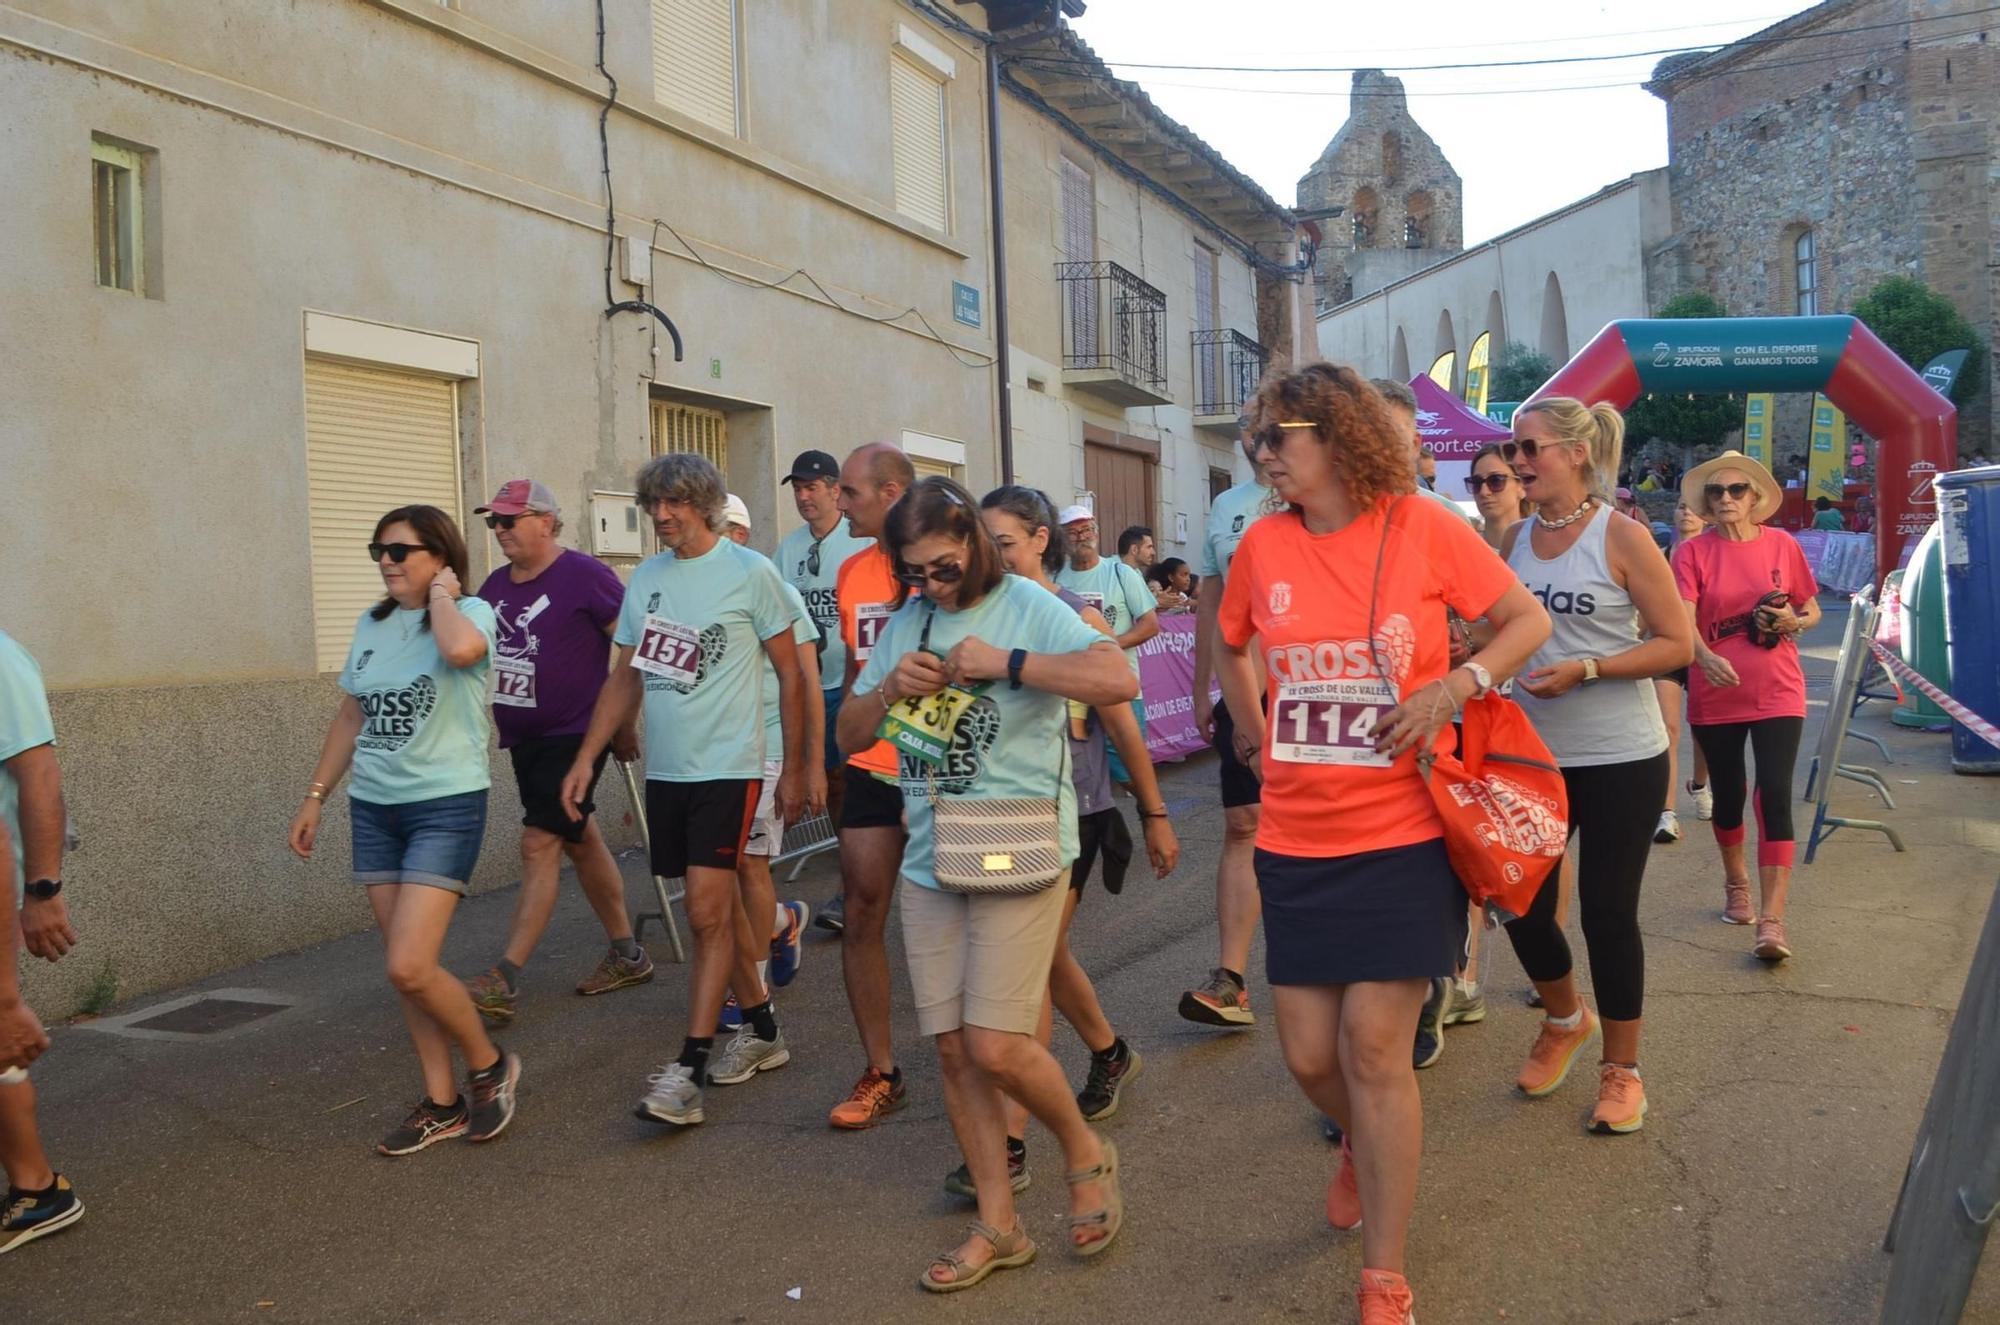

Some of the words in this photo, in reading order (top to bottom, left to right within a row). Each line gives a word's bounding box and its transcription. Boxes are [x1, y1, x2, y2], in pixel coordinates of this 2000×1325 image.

[1734, 347, 1756, 355] CON
[1772, 345, 1818, 354] DEPORTE
[1734, 357, 1783, 366] GANAMOS
[1785, 356, 1819, 365] TODOS
[1674, 356, 1723, 367] ZAMORA
[1525, 583, 1596, 616] das
[646, 632, 697, 670] 157
[1268, 640, 1393, 683] CROSS
[1298, 684, 1325, 696] CROSS
[1326, 684, 1338, 694] DE
[1339, 685, 1358, 695] LOS
[1287, 701, 1380, 746] 114
